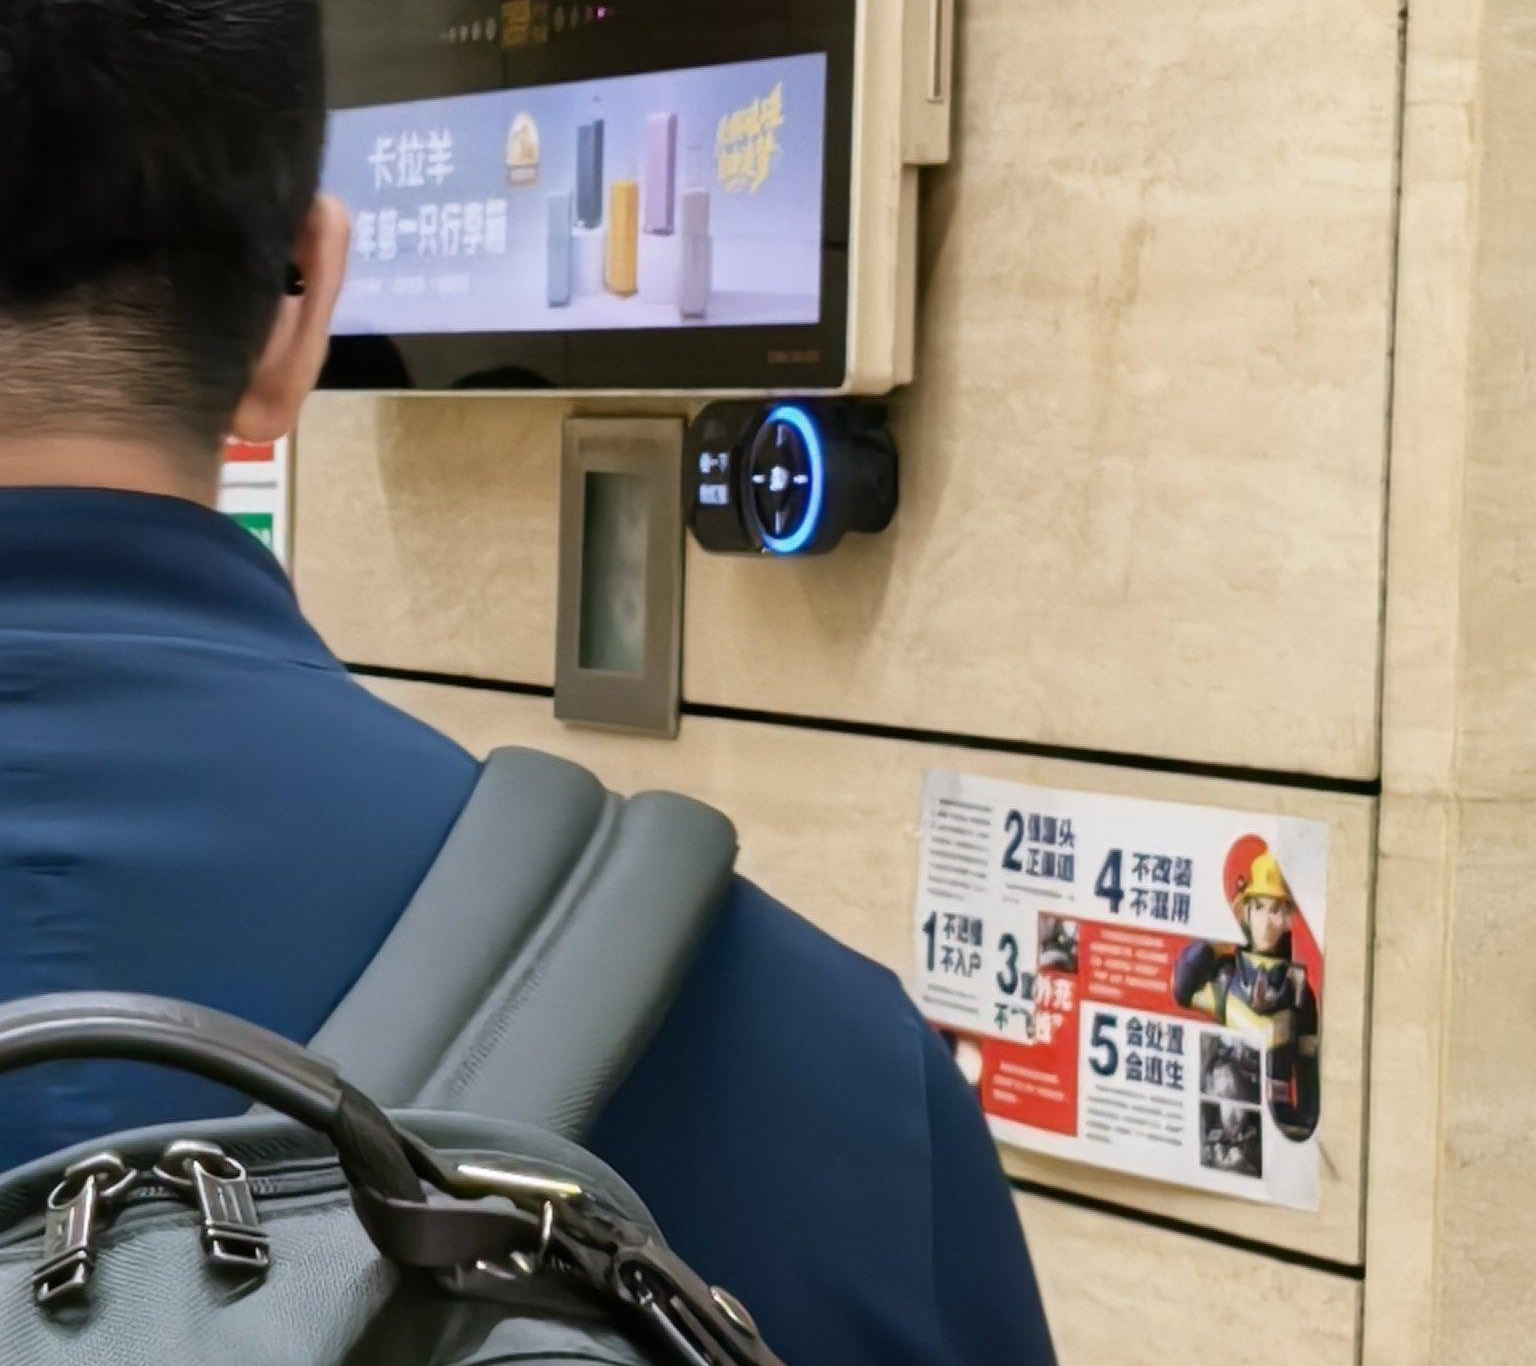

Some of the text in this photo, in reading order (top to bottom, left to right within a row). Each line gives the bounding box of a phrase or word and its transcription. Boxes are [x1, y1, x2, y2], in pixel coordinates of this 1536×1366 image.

[367, 129, 454, 189] 卡拉羊
[1001, 809, 1025, 872] 2
[1094, 848, 1125, 914] 4
[1132, 851, 1193, 888] 不改装
[922, 910, 937, 972] 1
[941, 946, 981, 977] 不入户
[996, 932, 1019, 995] 3
[1089, 1013, 1184, 1076] 5 会处置
[1126, 1051, 1184, 1090] 会逃生
